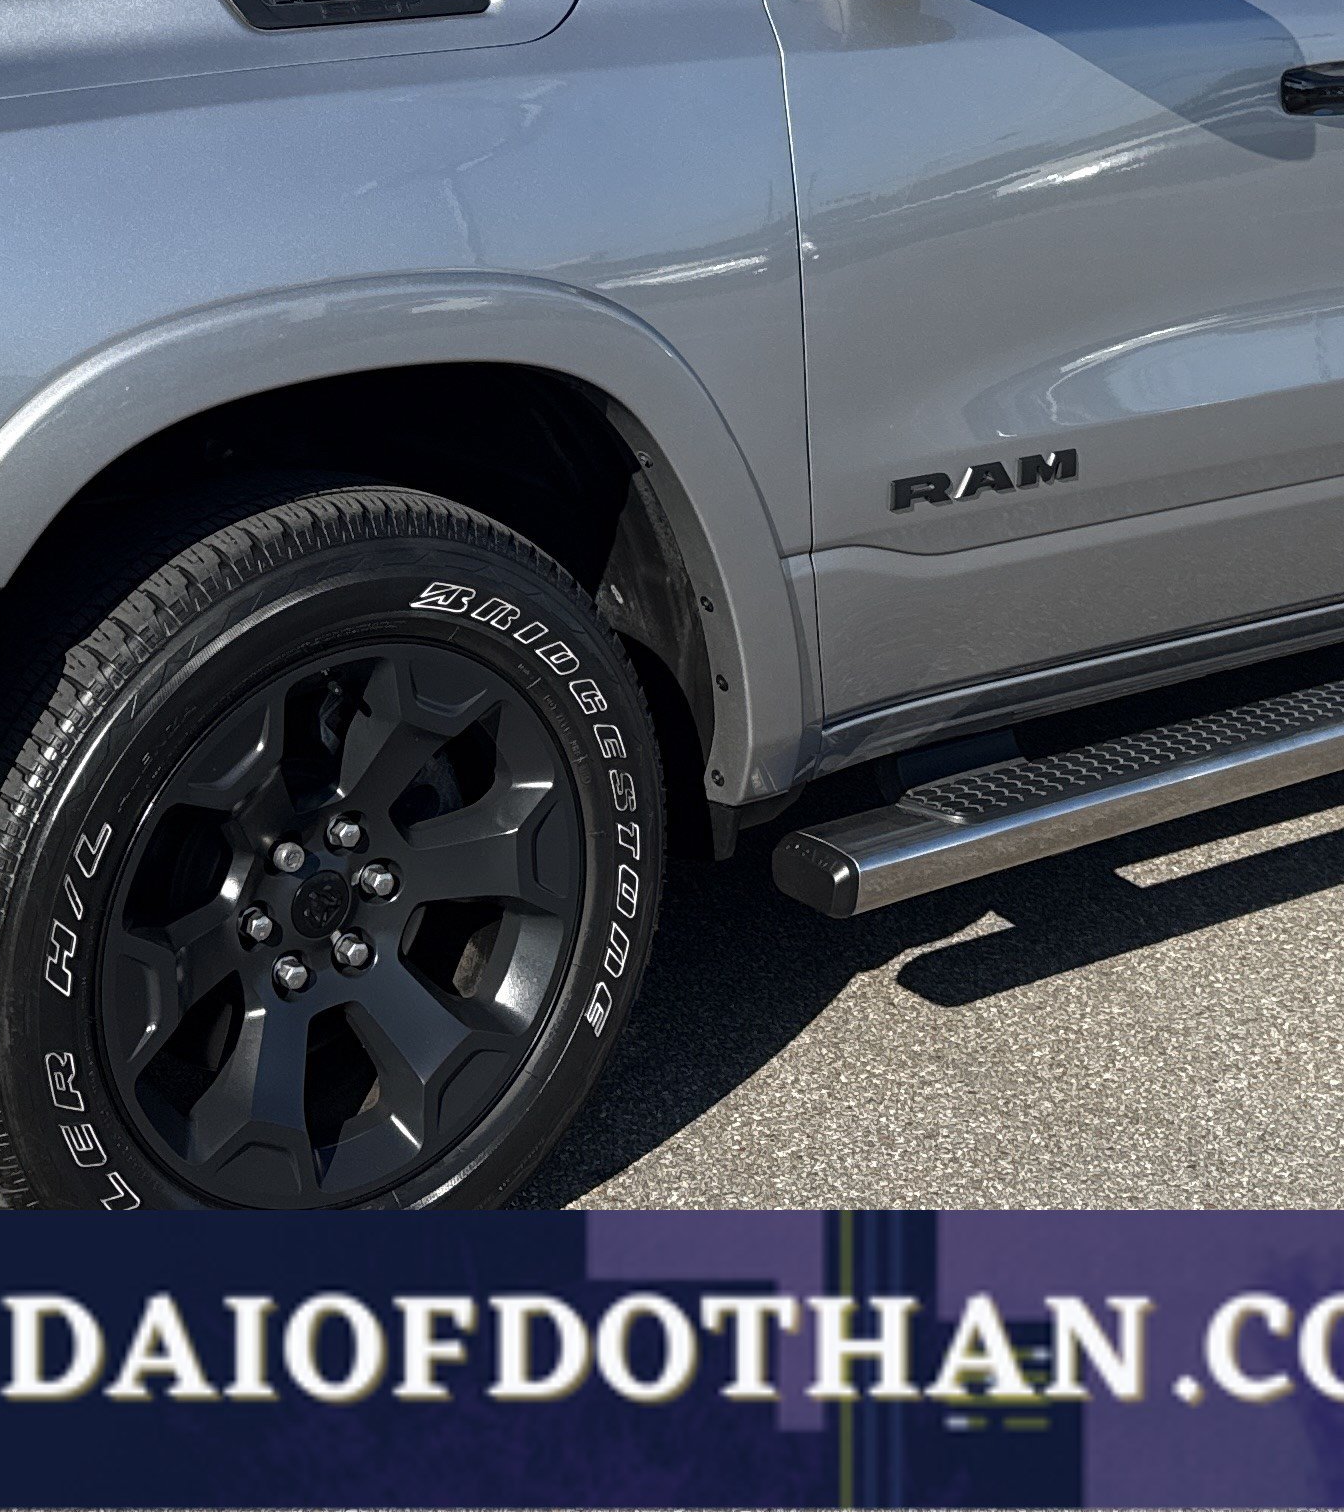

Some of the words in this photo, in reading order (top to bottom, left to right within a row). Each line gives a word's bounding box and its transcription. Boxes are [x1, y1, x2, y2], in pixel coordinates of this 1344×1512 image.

[890, 448, 1079, 513] RAM
[410, 582, 641, 1037] BRIDGESTONE
[45, 822, 112, 996] H/L
